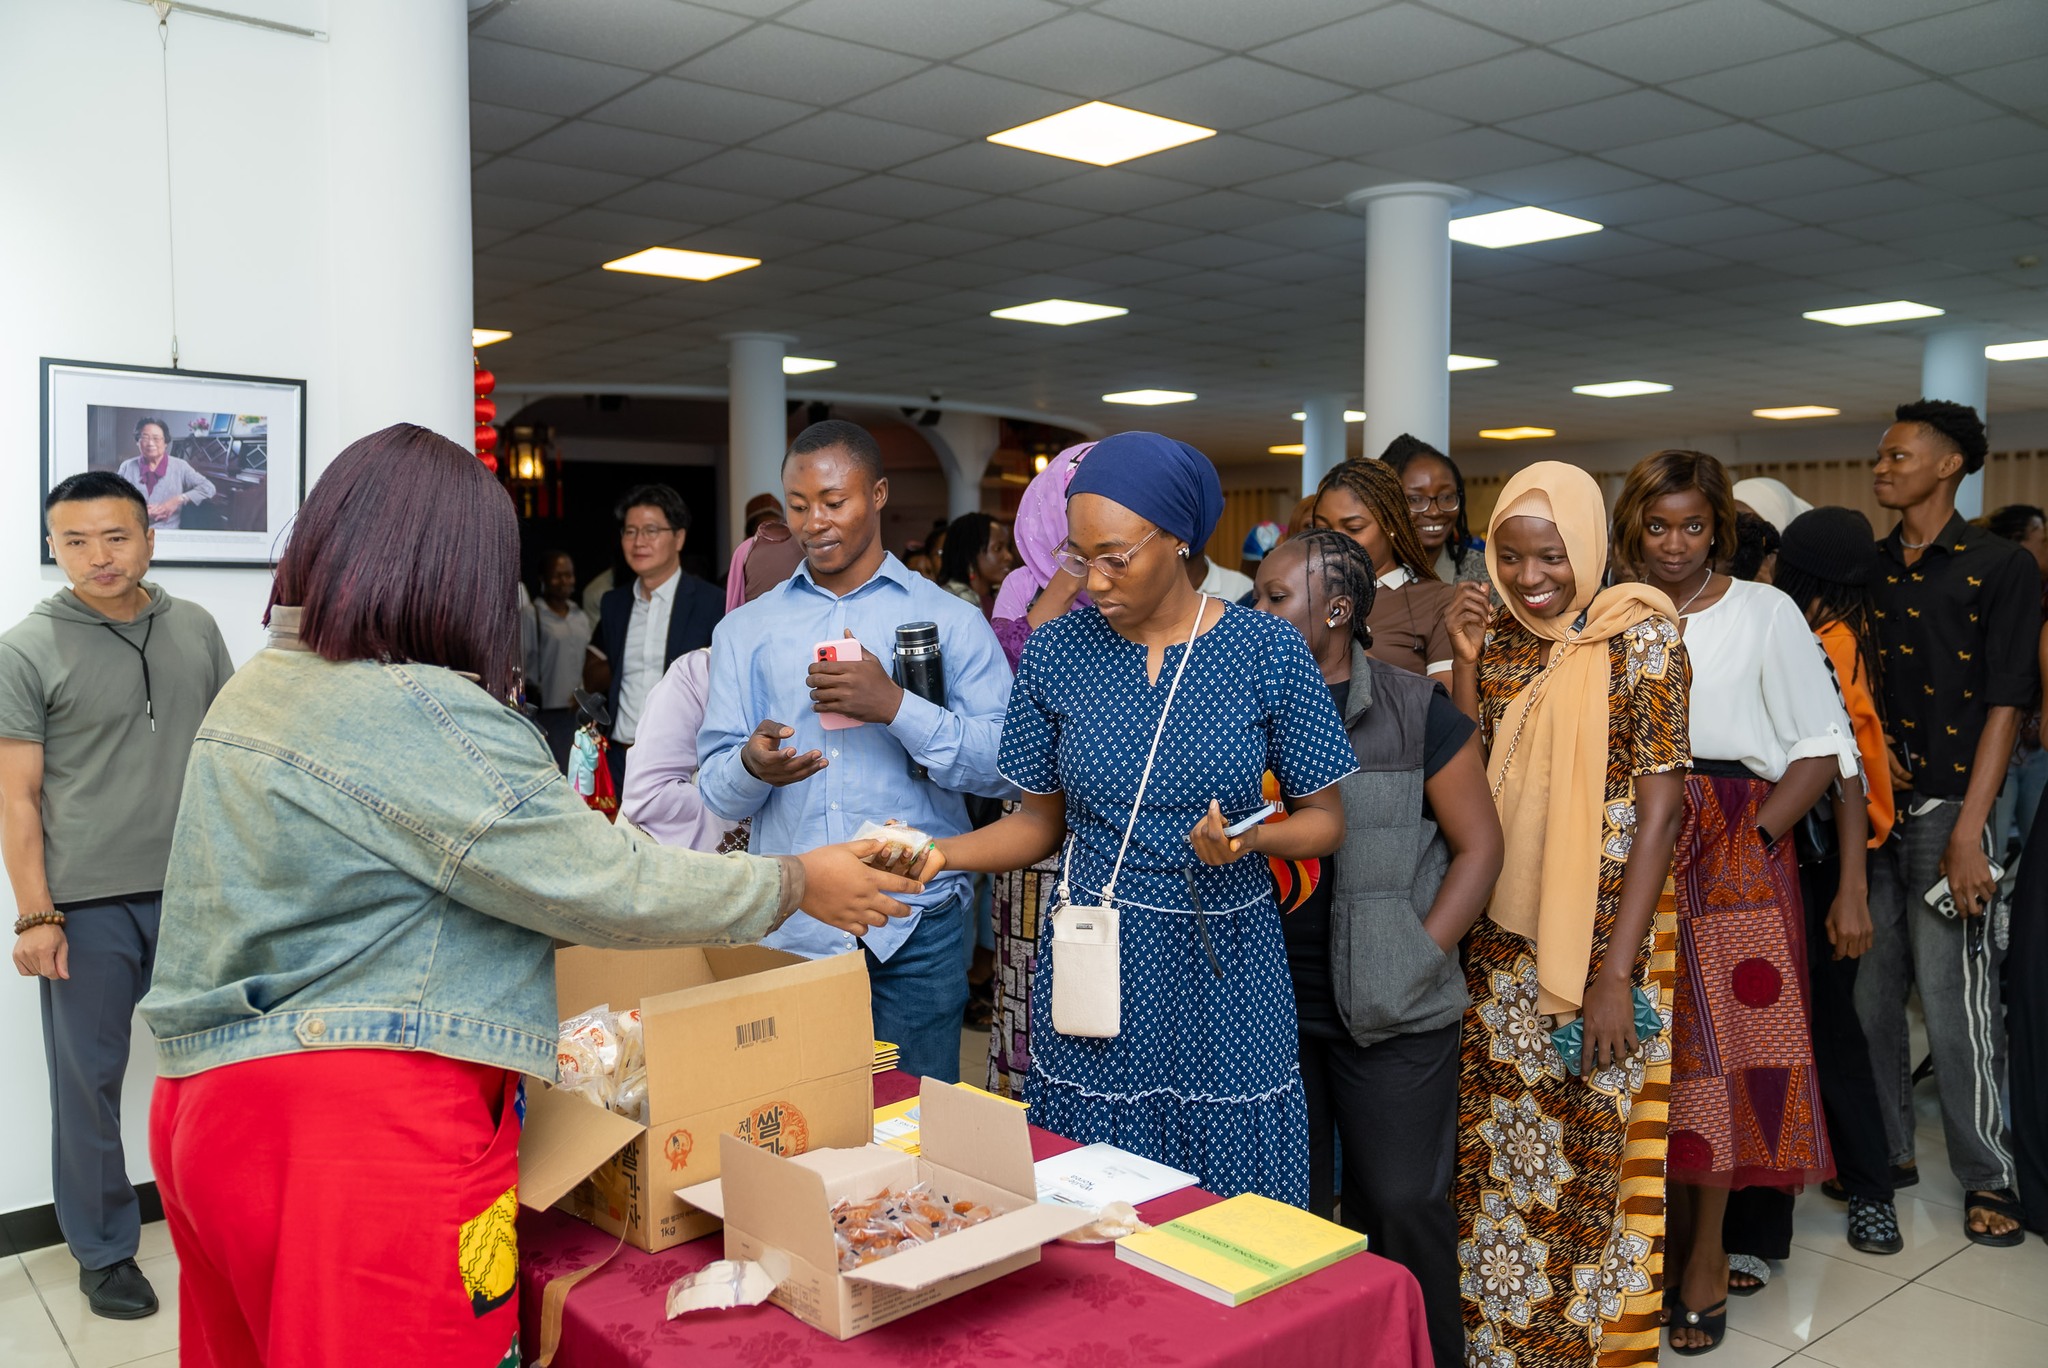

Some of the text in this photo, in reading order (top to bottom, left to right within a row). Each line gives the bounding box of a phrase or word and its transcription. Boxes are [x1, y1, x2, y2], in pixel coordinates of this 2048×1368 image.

[660, 1226, 676, 1238] 1kg
[1170, 1222, 1201, 1238] CULTURE
[1201, 1234, 1230, 1249] KOREAN
[1231, 1246, 1279, 1270] TRADITIONAL
